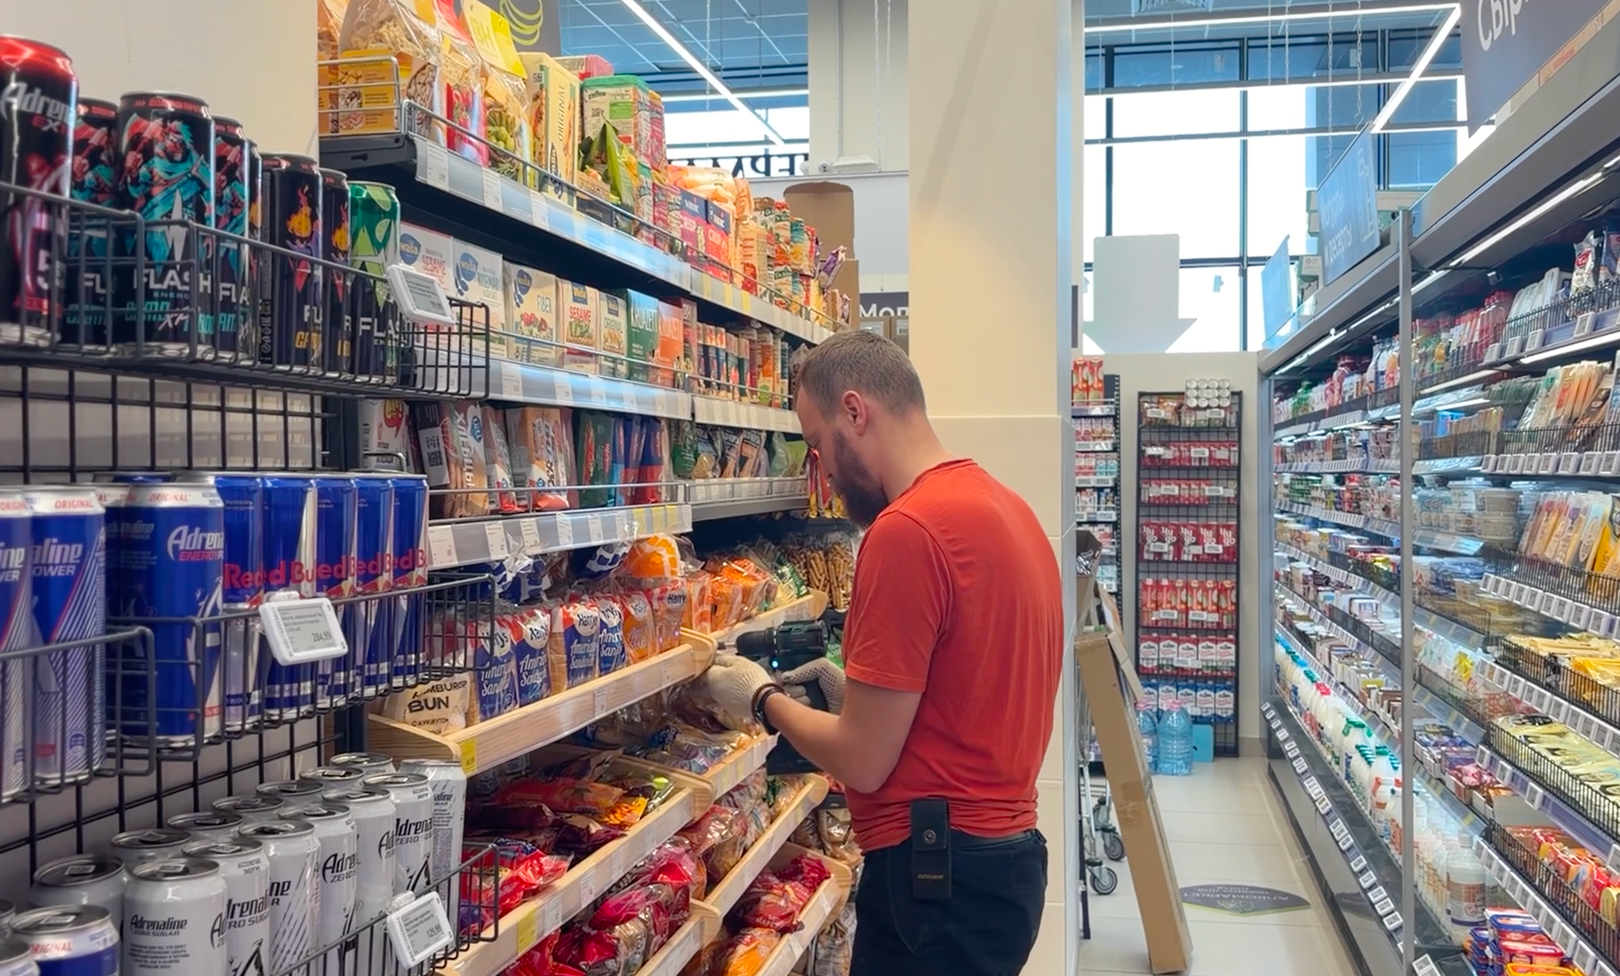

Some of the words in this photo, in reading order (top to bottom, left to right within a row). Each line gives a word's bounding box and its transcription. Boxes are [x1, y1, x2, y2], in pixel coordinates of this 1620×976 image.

[558, 85, 566, 142] ORIGINAL
[569, 306, 591, 324] SESAME
[455, 410, 476, 488] ХЛЕБЦЫ
[54, 499, 94, 510] ORIGINAL
[149, 492, 189, 502] ORIGINAL
[407, 696, 450, 714] BUN
[130, 914, 188, 936] Adrenaline
